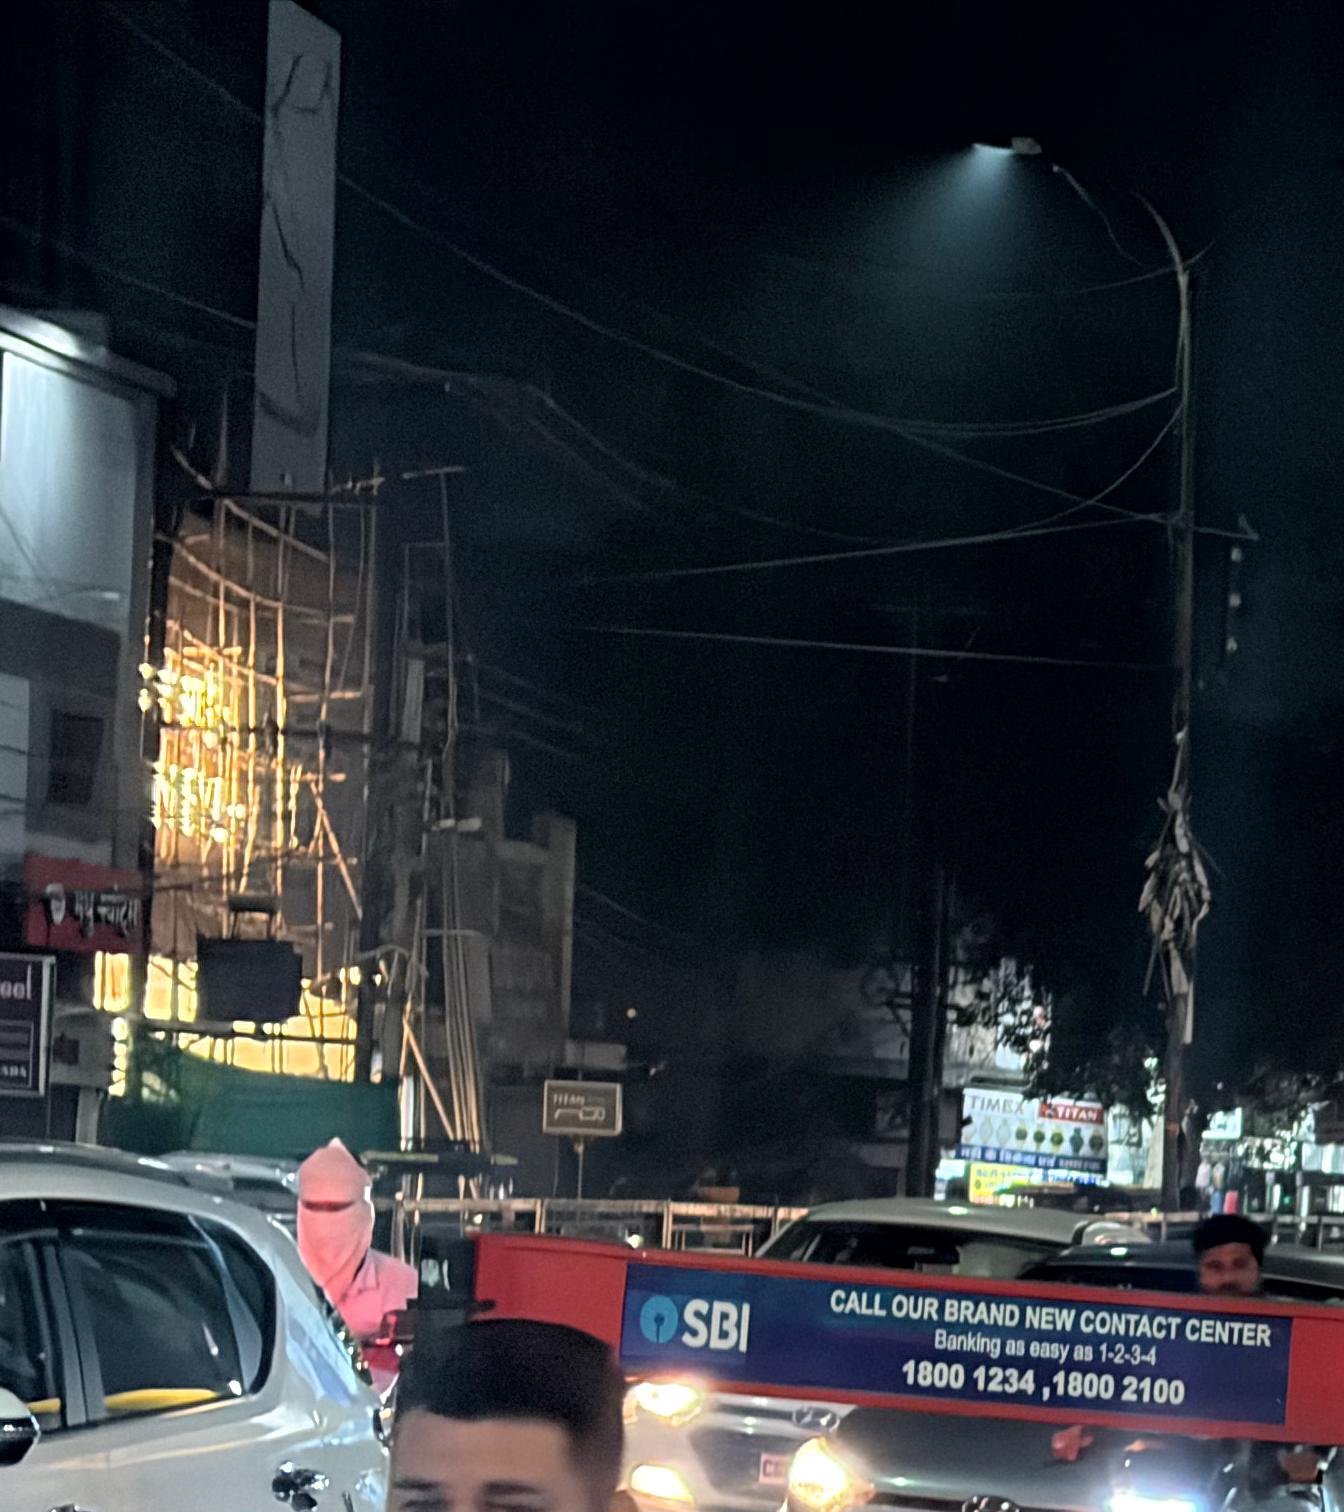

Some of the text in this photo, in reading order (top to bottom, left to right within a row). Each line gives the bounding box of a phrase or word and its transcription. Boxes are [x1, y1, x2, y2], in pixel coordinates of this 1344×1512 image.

[1057, 1106, 1098, 1121] TITAN
[681, 1297, 750, 1353] SBI
[830, 1289, 1272, 1347] CALL OUR BRAND NEW CONTACT CENTER
[934, 1328, 1158, 1367] Banking as easy as 1-2-3-4
[902, 1359, 965, 1390] 1800
[972, 1365, 1036, 1395] 1234
[1121, 1375, 1186, 1406] 2100
